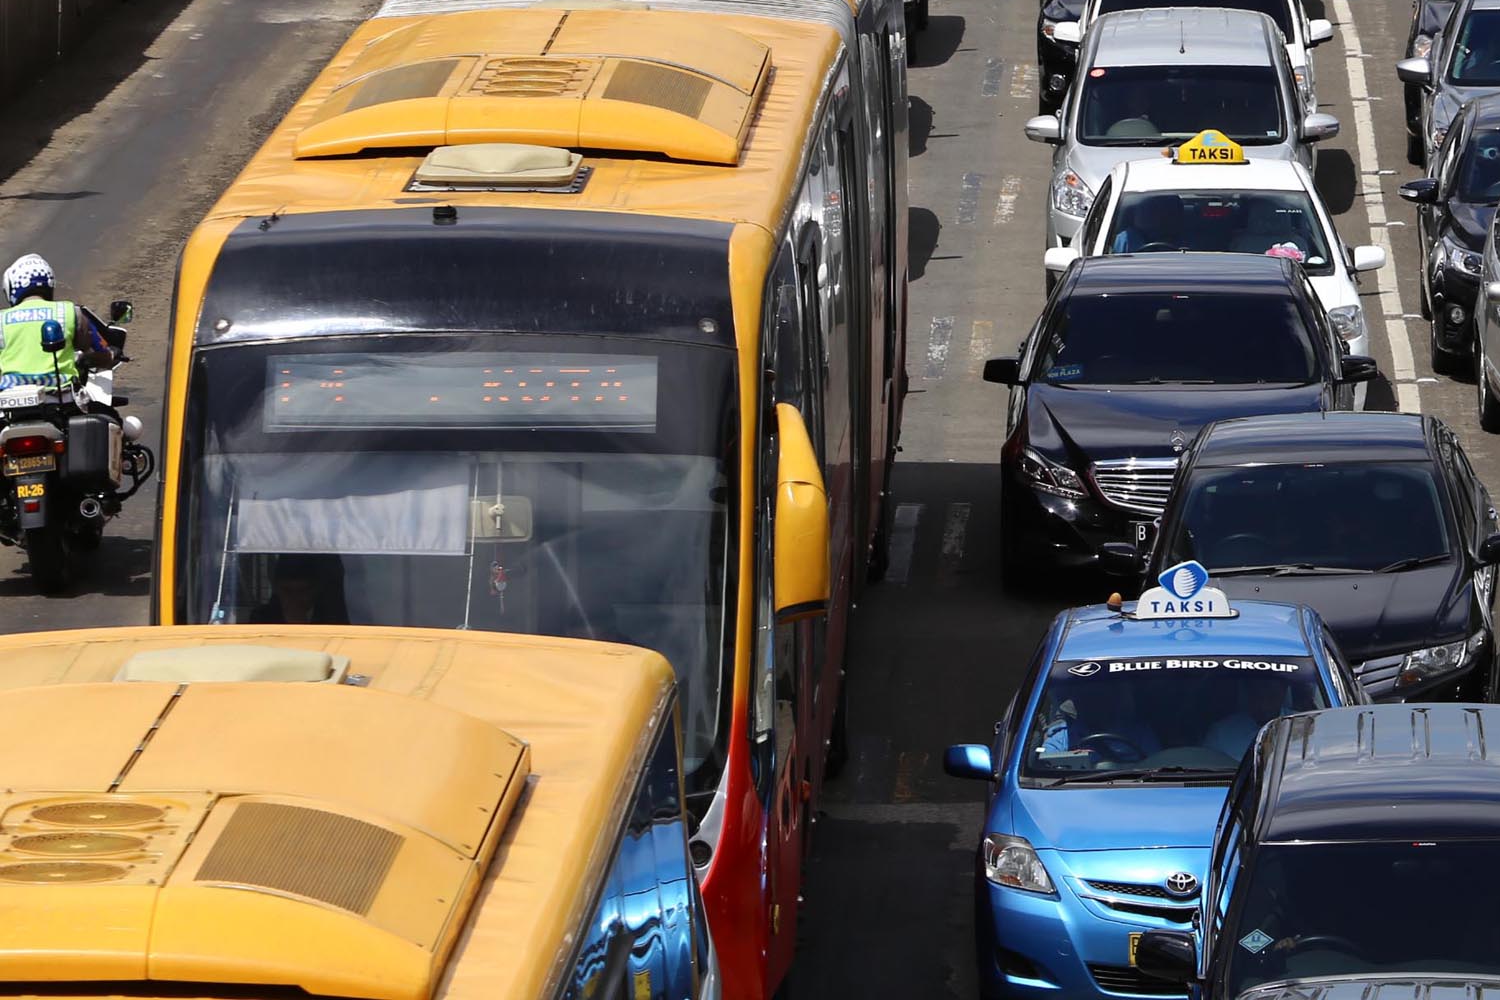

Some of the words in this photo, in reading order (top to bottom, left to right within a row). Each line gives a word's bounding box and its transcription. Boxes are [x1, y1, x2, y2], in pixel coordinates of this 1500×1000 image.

[1189, 148, 1234, 160] TAKSI
[6, 309, 52, 323] POLISI
[1, 397, 39, 407] POLISI
[1138, 525, 1147, 541] B
[1150, 601, 1213, 613] TAKSI
[1109, 662, 1162, 672] BLUE
[1166, 660, 1219, 669] BIRD
[1222, 660, 1299, 672] GROUP
